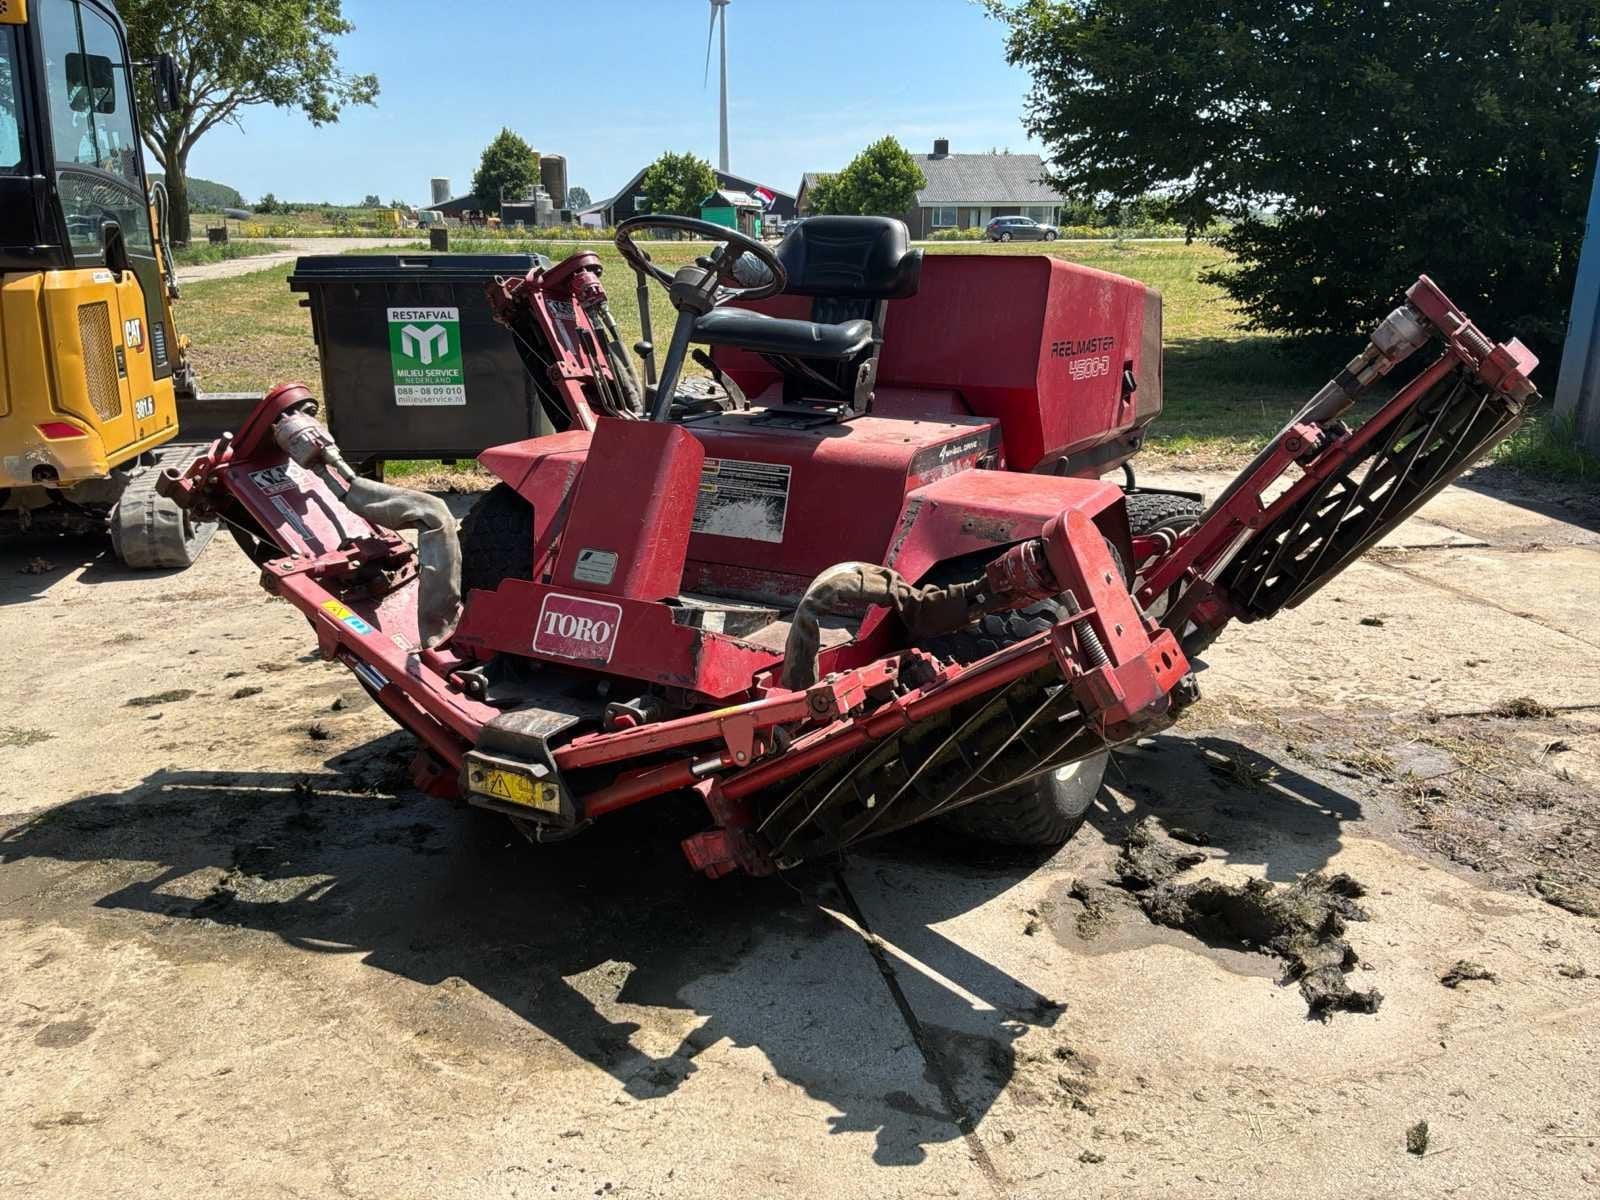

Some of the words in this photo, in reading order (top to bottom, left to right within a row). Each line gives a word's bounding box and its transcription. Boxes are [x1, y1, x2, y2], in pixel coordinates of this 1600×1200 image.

[392, 311, 454, 320] RESTAFVAL
[125, 320, 141, 347] CAT
[1051, 337, 1114, 358] REELMASTER
[397, 369, 424, 377] MILIEU
[426, 369, 459, 377] SERVICE
[397, 387, 413, 395] 088
[420, 387, 431, 395] 08
[433, 387, 444, 395] 09
[446, 387, 462, 395] 010
[398, 395, 463, 403] milieuservice.nl
[544, 611, 611, 643] TORO
